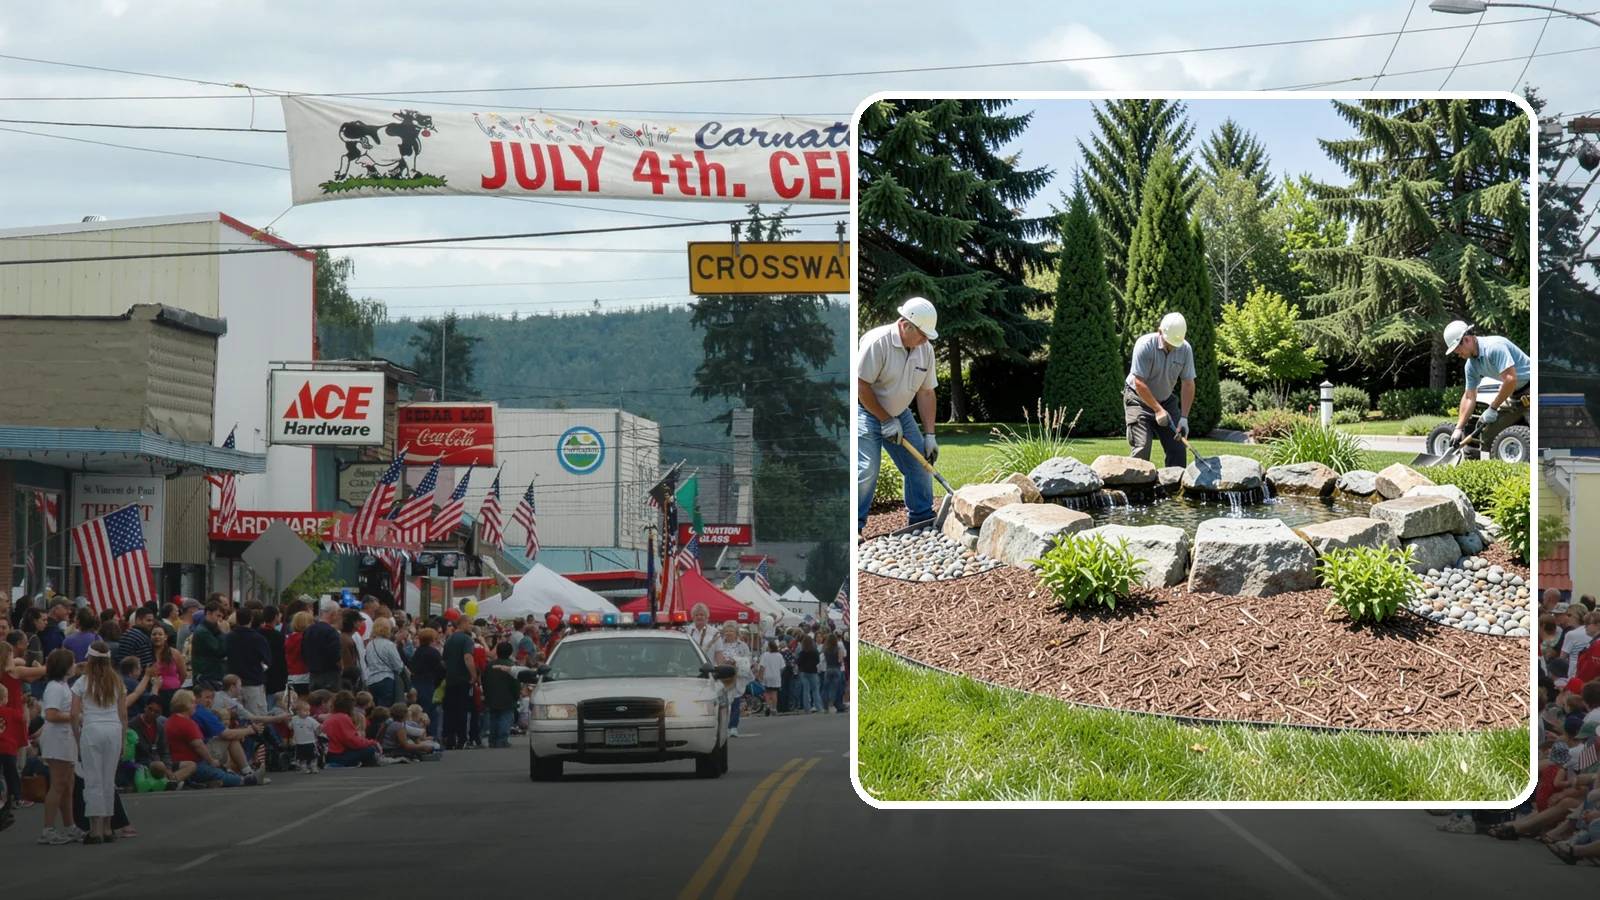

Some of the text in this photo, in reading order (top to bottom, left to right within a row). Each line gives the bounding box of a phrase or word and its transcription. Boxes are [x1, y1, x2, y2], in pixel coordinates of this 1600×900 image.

[481, 141, 605, 193] JULY
[632, 150, 746, 197] 4th.
[697, 254, 850, 279] CROSSWA
[283, 380, 374, 420] ACE
[405, 409, 452, 422] CEDAR
[284, 421, 371, 436] Hardware
[416, 428, 477, 447] Coca-Cola
[353, 467, 386, 482] Simpl
[95, 485, 124, 495] Vincent
[126, 486, 136, 495] de
[138, 486, 155, 495] Paul
[688, 526, 741, 535] CRNATION
[699, 535, 730, 543] GLASS
